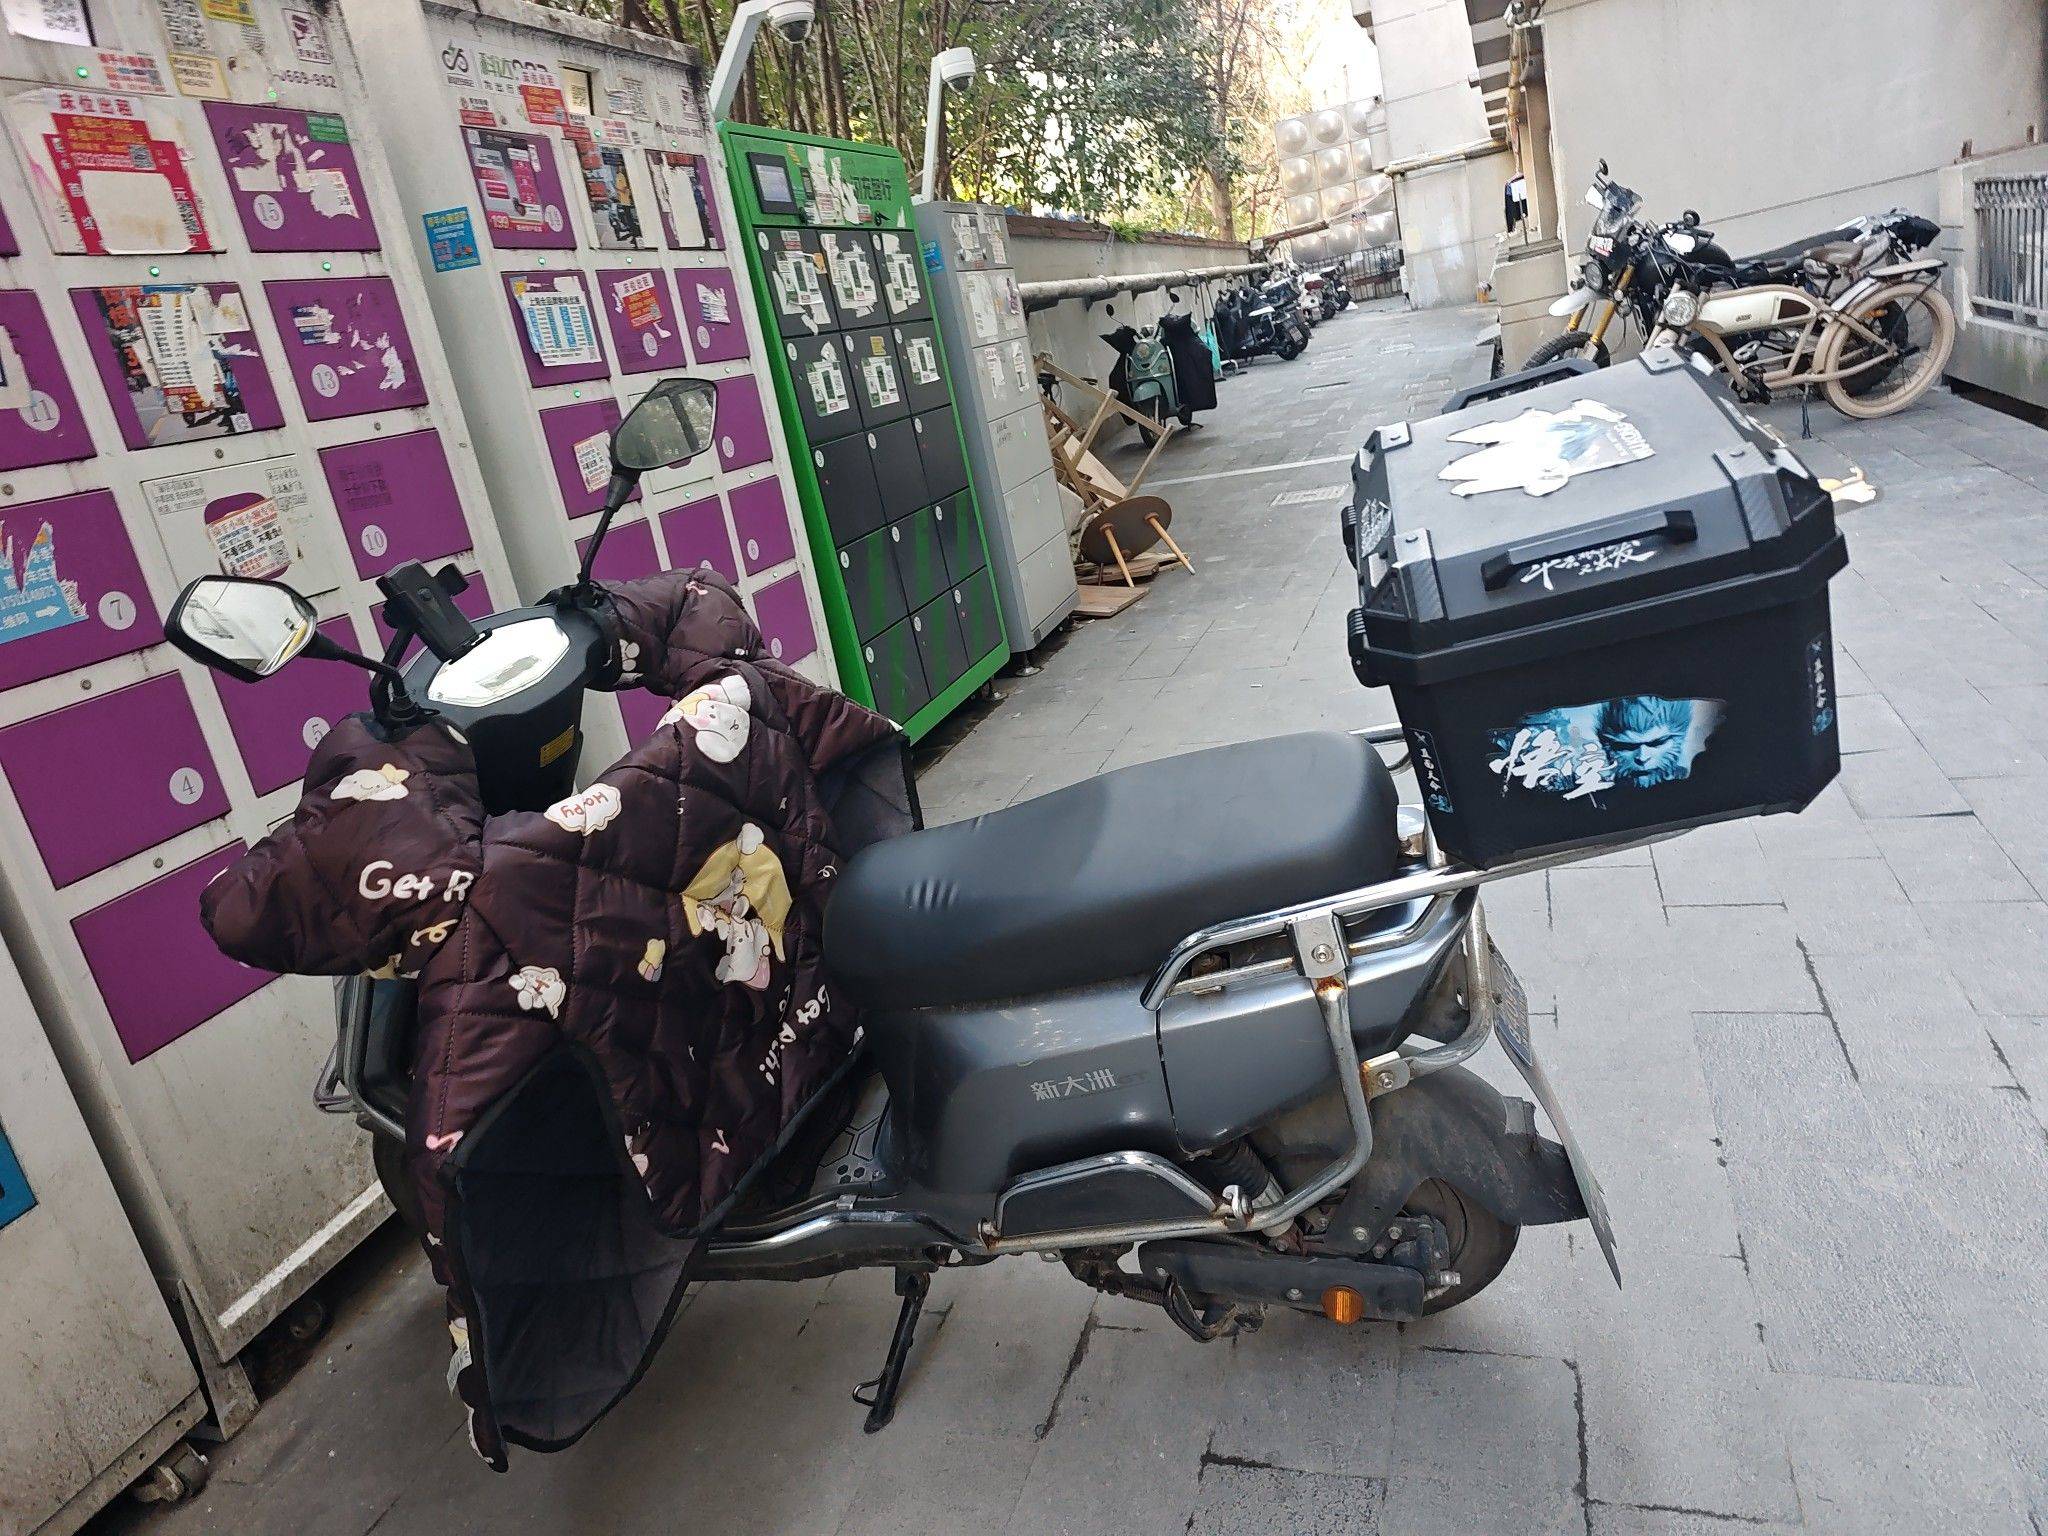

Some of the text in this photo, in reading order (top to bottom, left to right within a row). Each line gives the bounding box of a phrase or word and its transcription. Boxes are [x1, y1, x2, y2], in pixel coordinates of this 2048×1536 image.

[315, 370, 337, 392] 13
[365, 530, 385, 552] 10
[108, 599, 124, 622] 7
[311, 723, 325, 744] 5
[1489, 728, 1617, 806] 悟空
[182, 775, 196, 796] 4
[358, 860, 435, 901] Get
[1030, 1068, 1117, 1101] 新大洲
